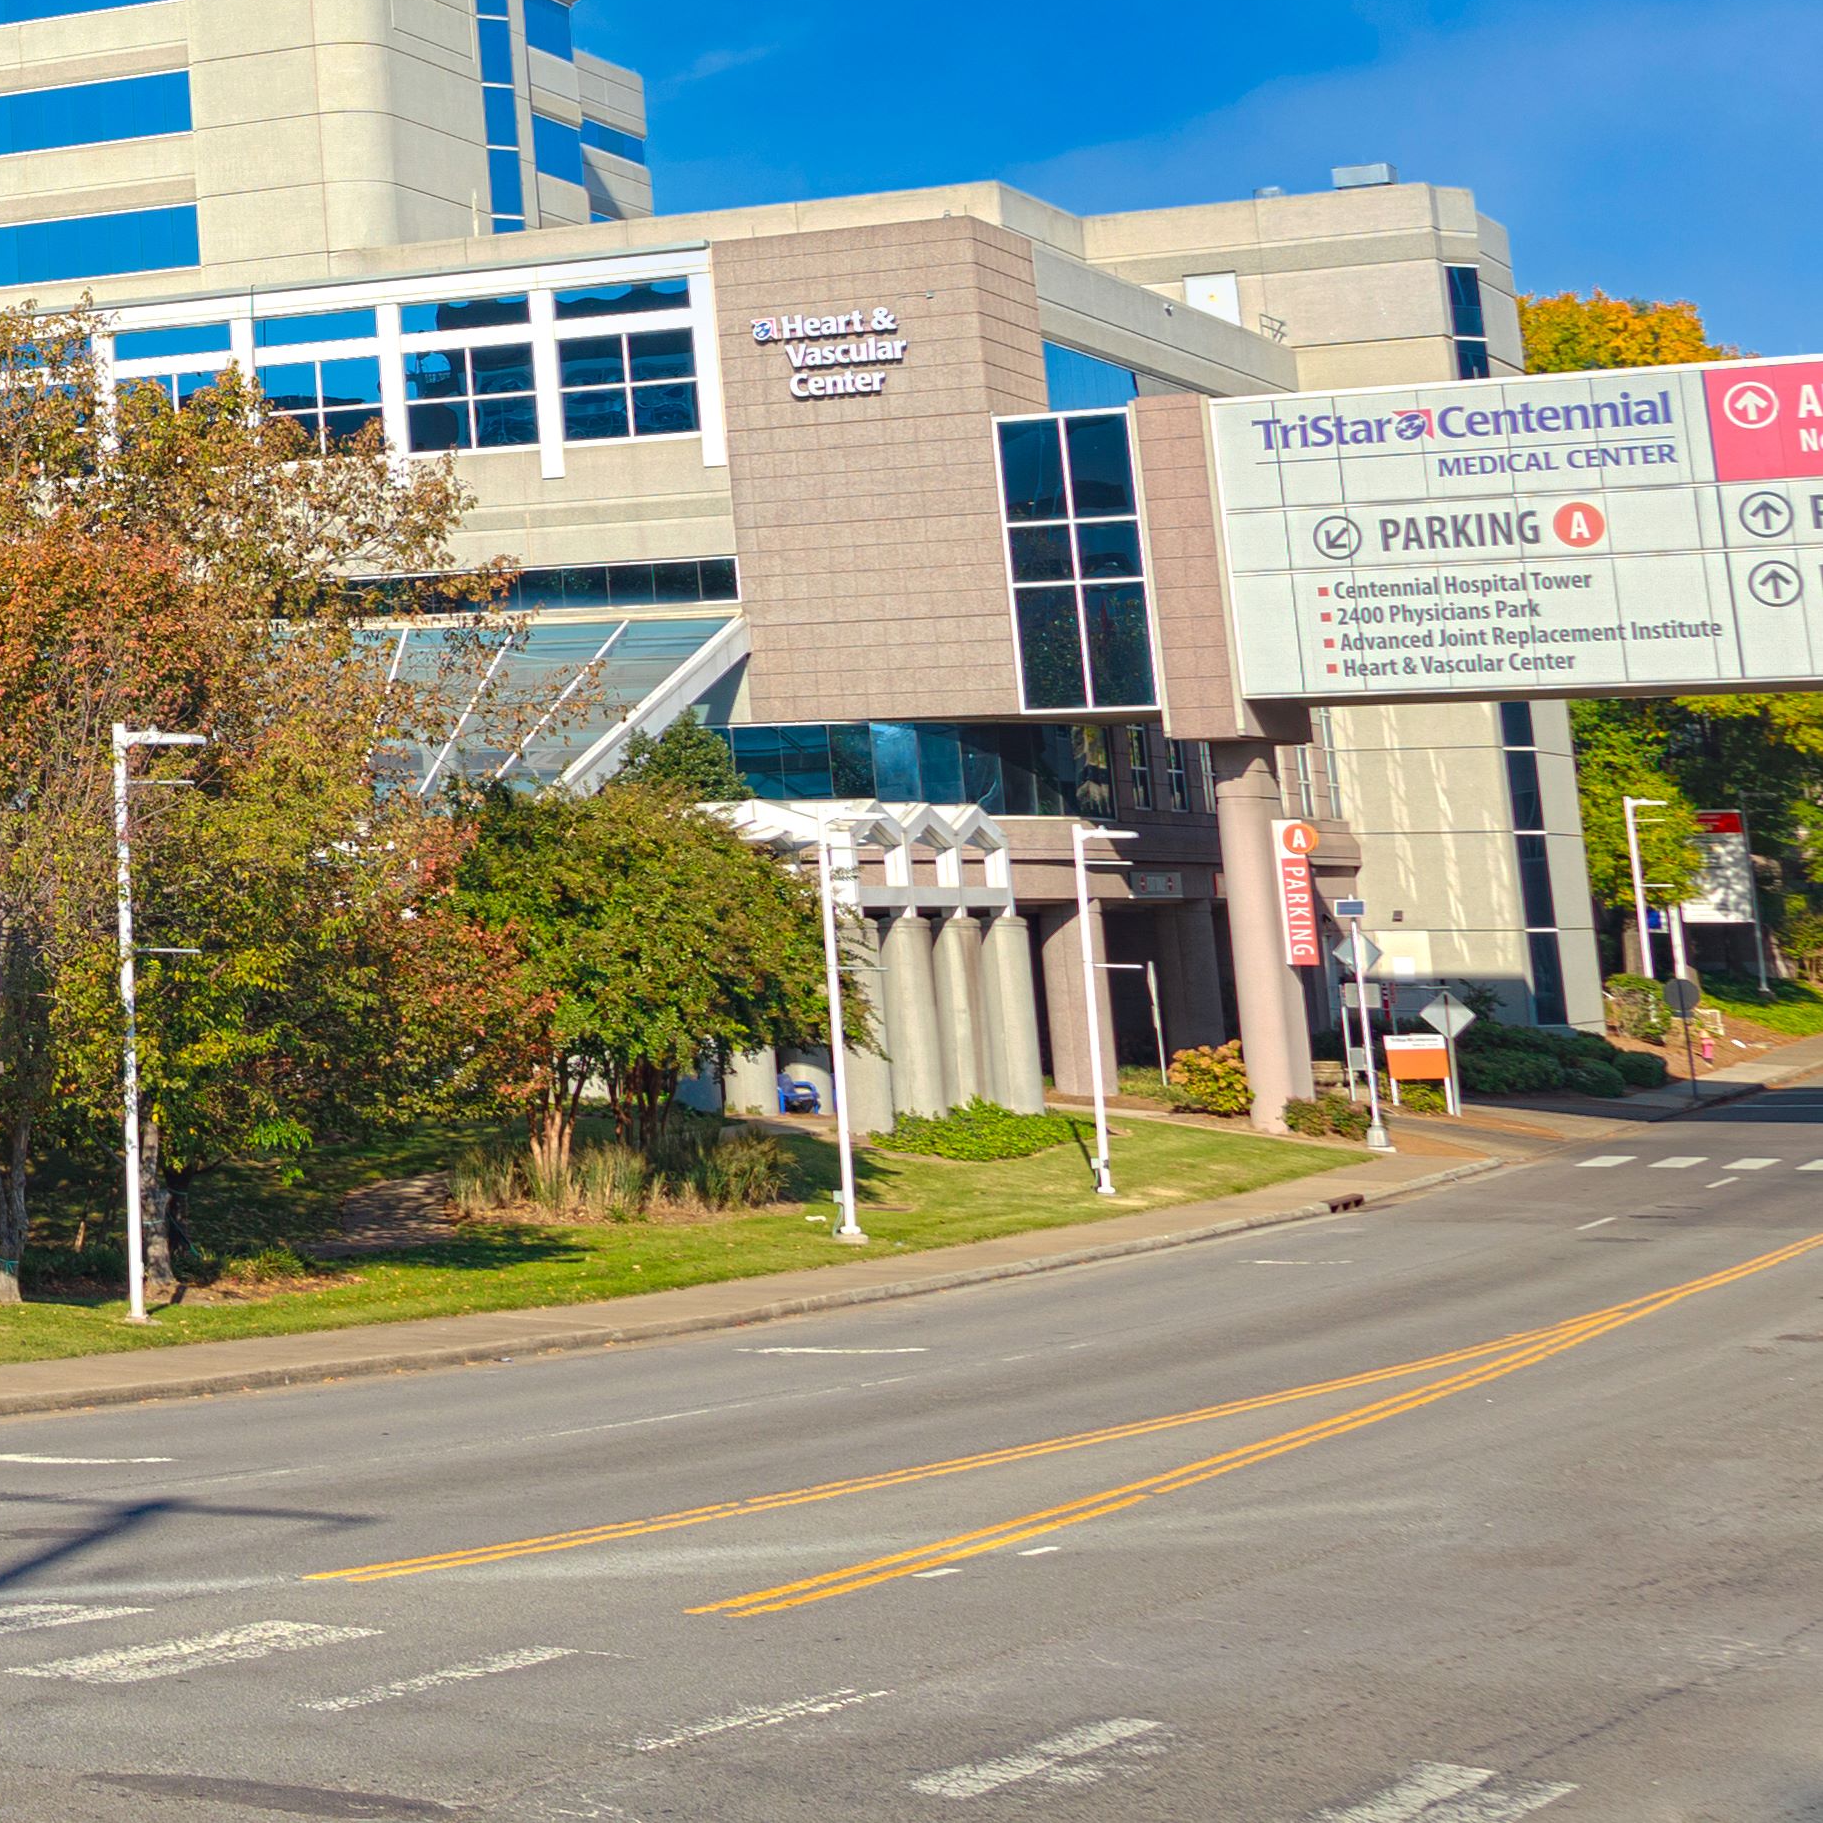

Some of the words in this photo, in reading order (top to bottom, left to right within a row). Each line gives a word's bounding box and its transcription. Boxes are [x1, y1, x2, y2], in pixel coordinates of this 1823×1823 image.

[780, 309, 864, 339] Heart
[871, 306, 898, 331] &
[785, 337, 907, 368] Vascular
[789, 370, 886, 398] Center
[1797, 384, 1823, 418] A
[1251, 414, 1392, 451] TriStar
[1437, 390, 1674, 439] Centennial
[1799, 428, 1823, 452] N
[1437, 451, 1559, 477] MEDICAL
[1566, 444, 1678, 469] CENTER
[1379, 509, 1542, 552] PARKING
[1570, 511, 1591, 539] A
[1334, 577, 1439, 600] Centennial
[1445, 573, 1528, 598] Hospital
[1532, 571, 1592, 591] Tower
[1337, 606, 1384, 625] 2400
[1389, 602, 1492, 627] Physicians
[1495, 599, 1541, 619] Park
[1340, 627, 1433, 651] Advanced
[1437, 626, 1488, 648] Joint
[1492, 623, 1626, 648] Replacement
[1630, 620, 1723, 640] Institute
[1343, 657, 1398, 678] Heart
[1402, 656, 1417, 674] &
[1420, 654, 1506, 675] Vascular
[1508, 652, 1576, 672] Center
[1292, 828, 1306, 848] A
[1284, 866, 1315, 956] PARKING
